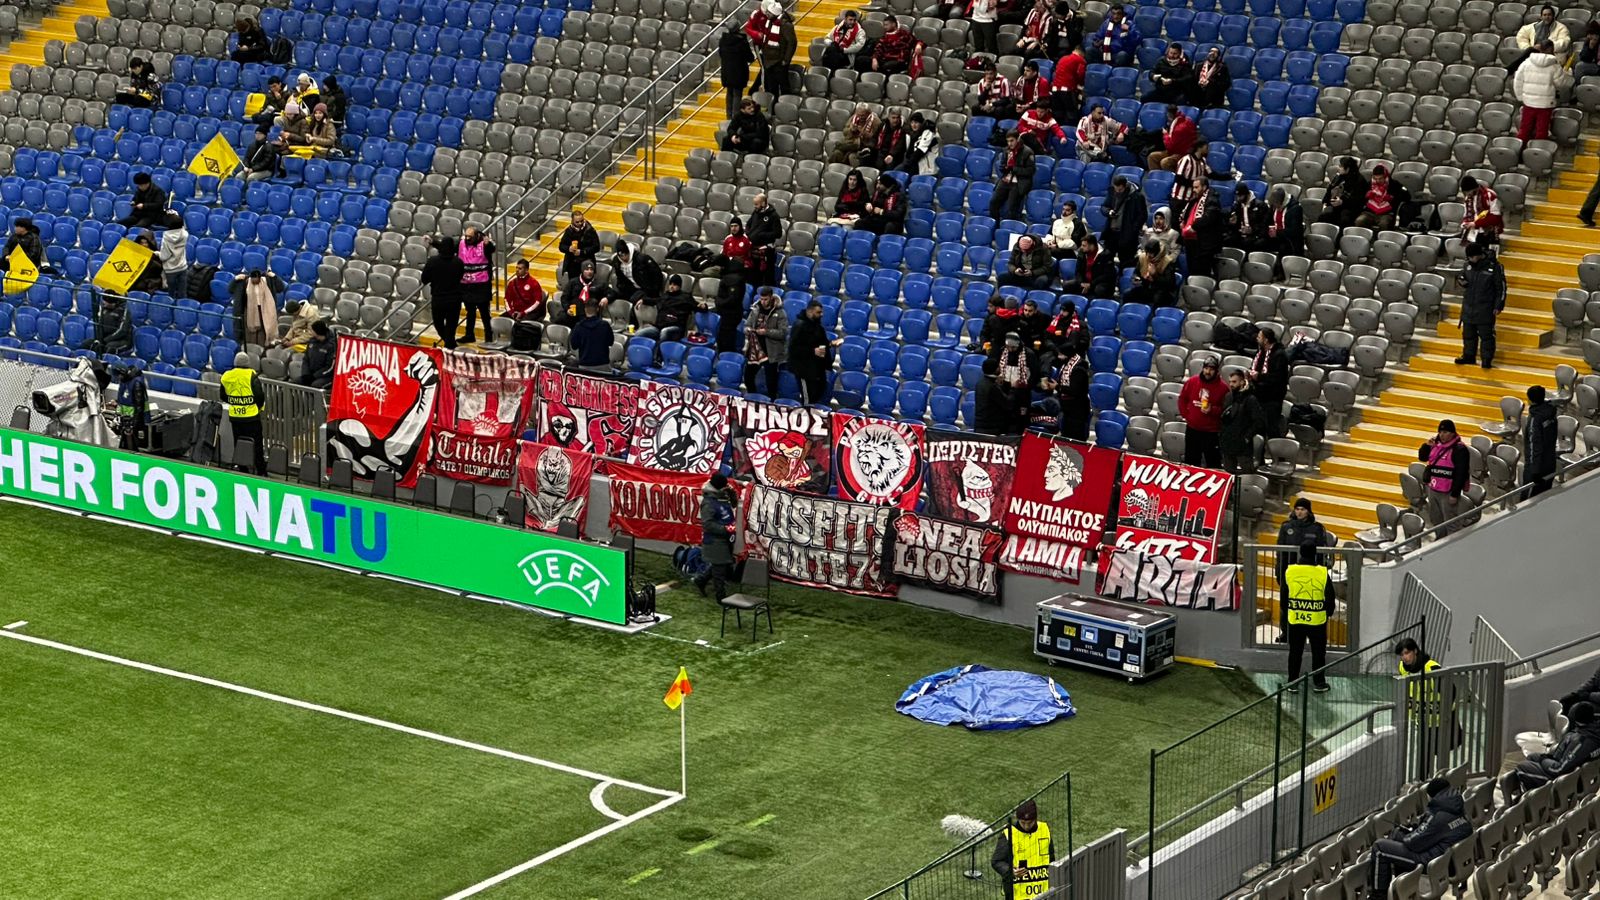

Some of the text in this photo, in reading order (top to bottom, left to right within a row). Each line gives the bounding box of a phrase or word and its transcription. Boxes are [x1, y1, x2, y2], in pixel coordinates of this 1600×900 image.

[336, 338, 400, 386] KAMINIA
[233, 406, 247, 415] 198
[647, 387, 721, 427] SEPOLIA
[732, 397, 829, 436] ΤΗΝΟΣ
[437, 430, 512, 466] Trikala
[1123, 459, 1226, 498] MUNICH
[110, 458, 222, 531] FOR
[233, 483, 387, 563] NATU
[1009, 496, 1105, 532] ΝΑΥΠΑΚΤΟΣ
[916, 518, 982, 560] NEA
[1017, 518, 1090, 544] ΟΛΥΜΠΙΑΚΟΣ
[522, 557, 601, 602] UEFA
[894, 542, 997, 593] LIOSIA
[1101, 549, 1237, 610] ARTA
[1295, 612, 1313, 622] 145
[1314, 775, 1336, 807] W9
